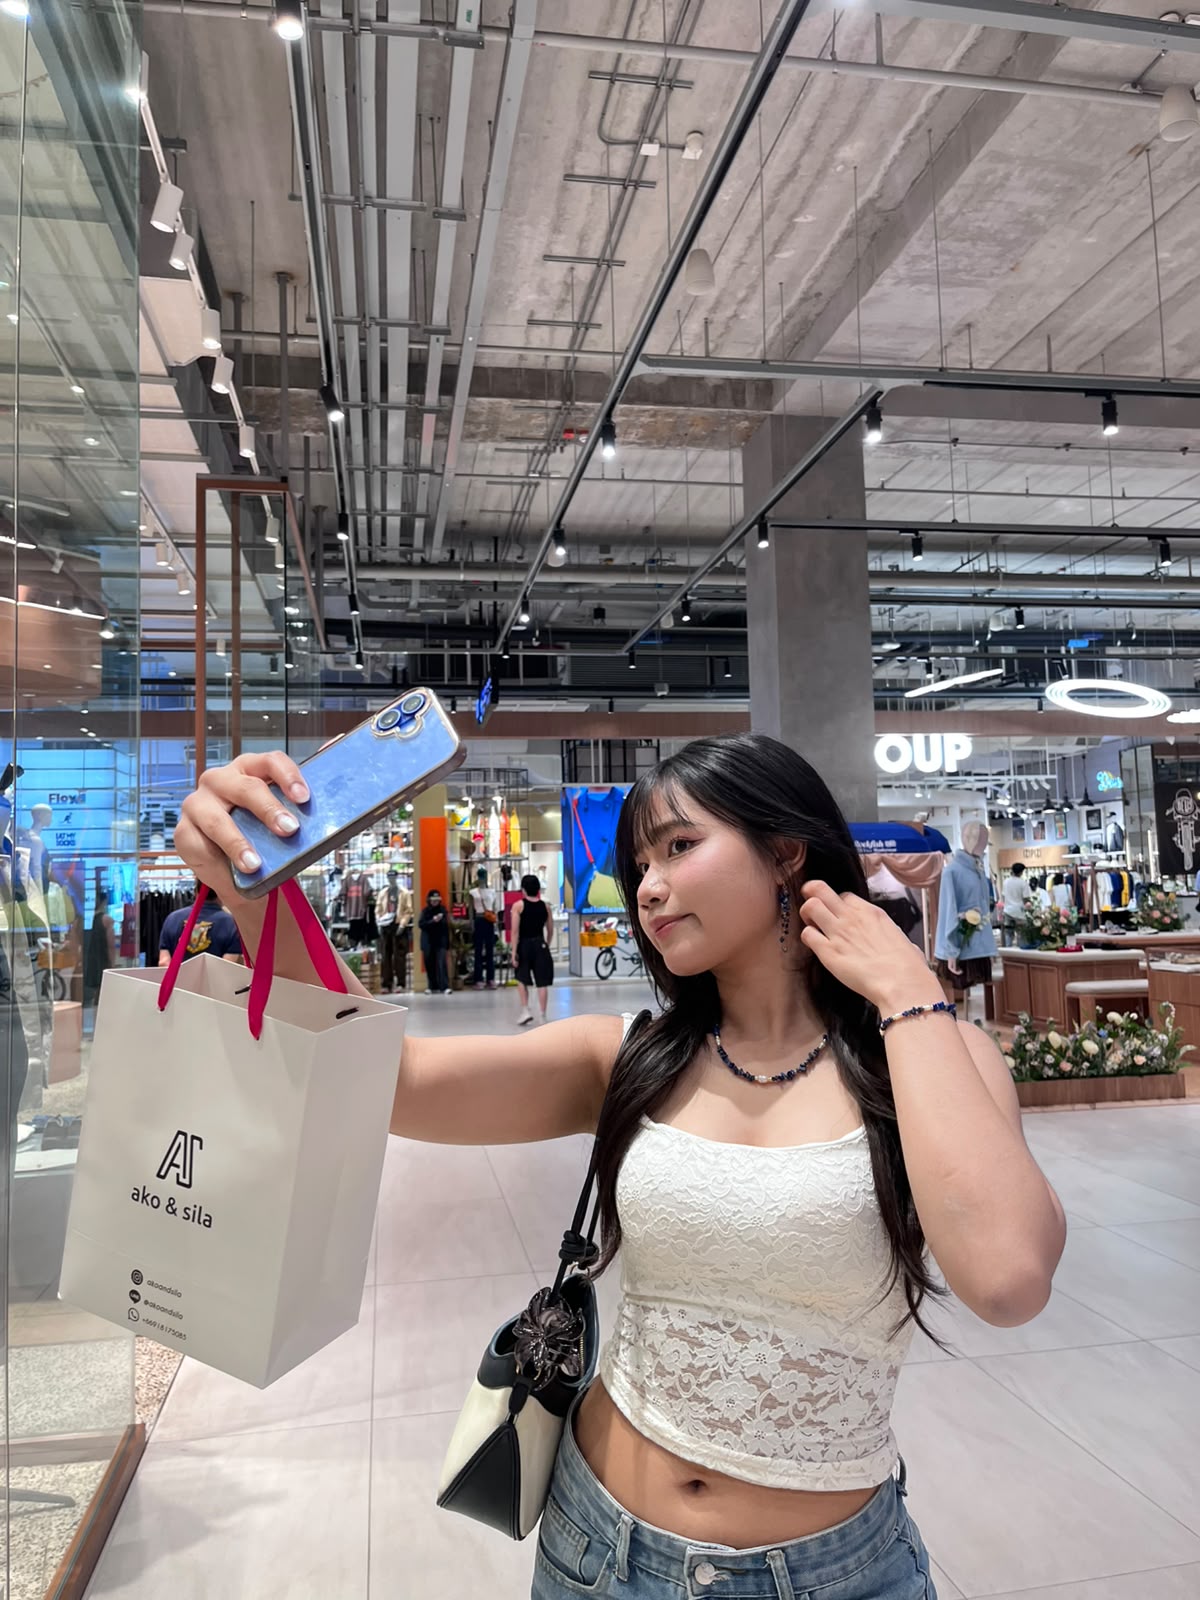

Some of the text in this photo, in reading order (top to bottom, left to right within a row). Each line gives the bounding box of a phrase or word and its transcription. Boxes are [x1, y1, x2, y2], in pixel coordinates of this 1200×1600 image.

[131, 1185, 213, 1228] ako & sila
[146, 1279, 182, 1298] akoandsila
